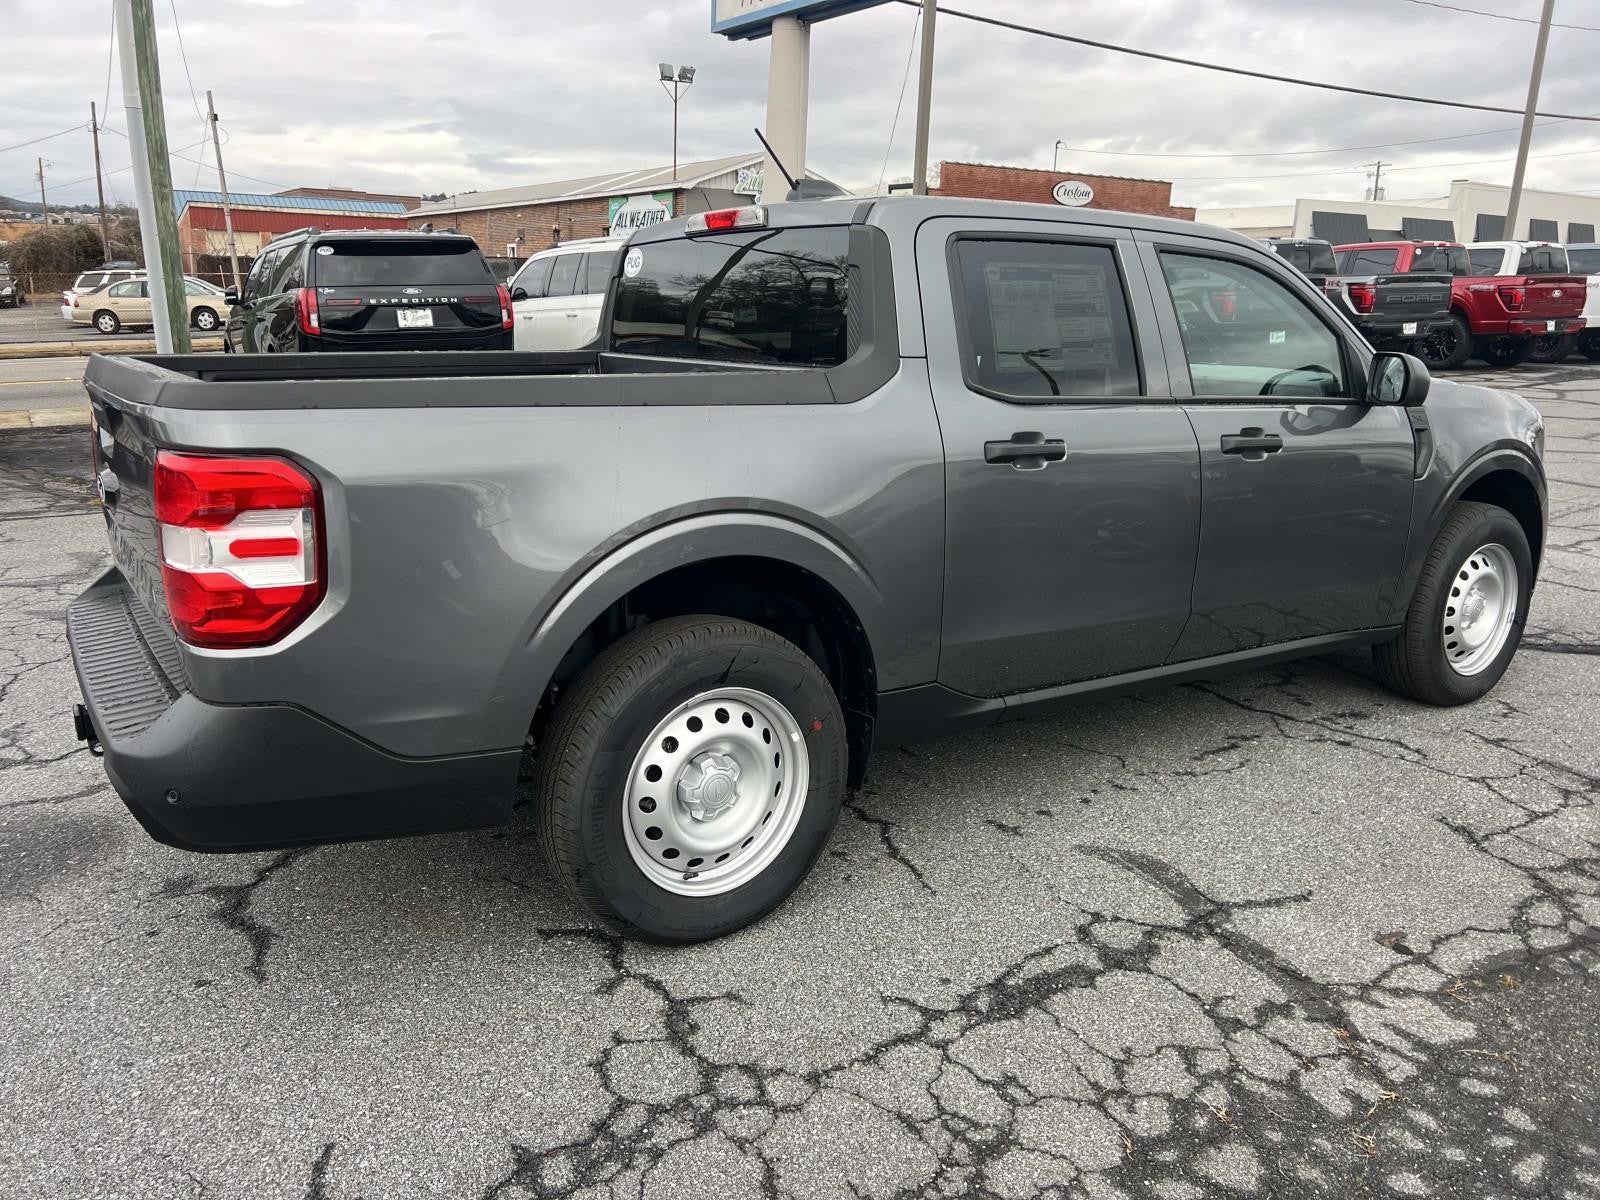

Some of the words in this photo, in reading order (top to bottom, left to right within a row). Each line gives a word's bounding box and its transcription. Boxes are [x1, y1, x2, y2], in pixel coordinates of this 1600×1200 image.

[1056, 184, 1092, 199] Custom
[614, 211, 628, 231] ALL
[629, 209, 666, 229] WEATHER
[626, 255, 641, 269] PUG
[369, 296, 458, 304] EXPEDITION
